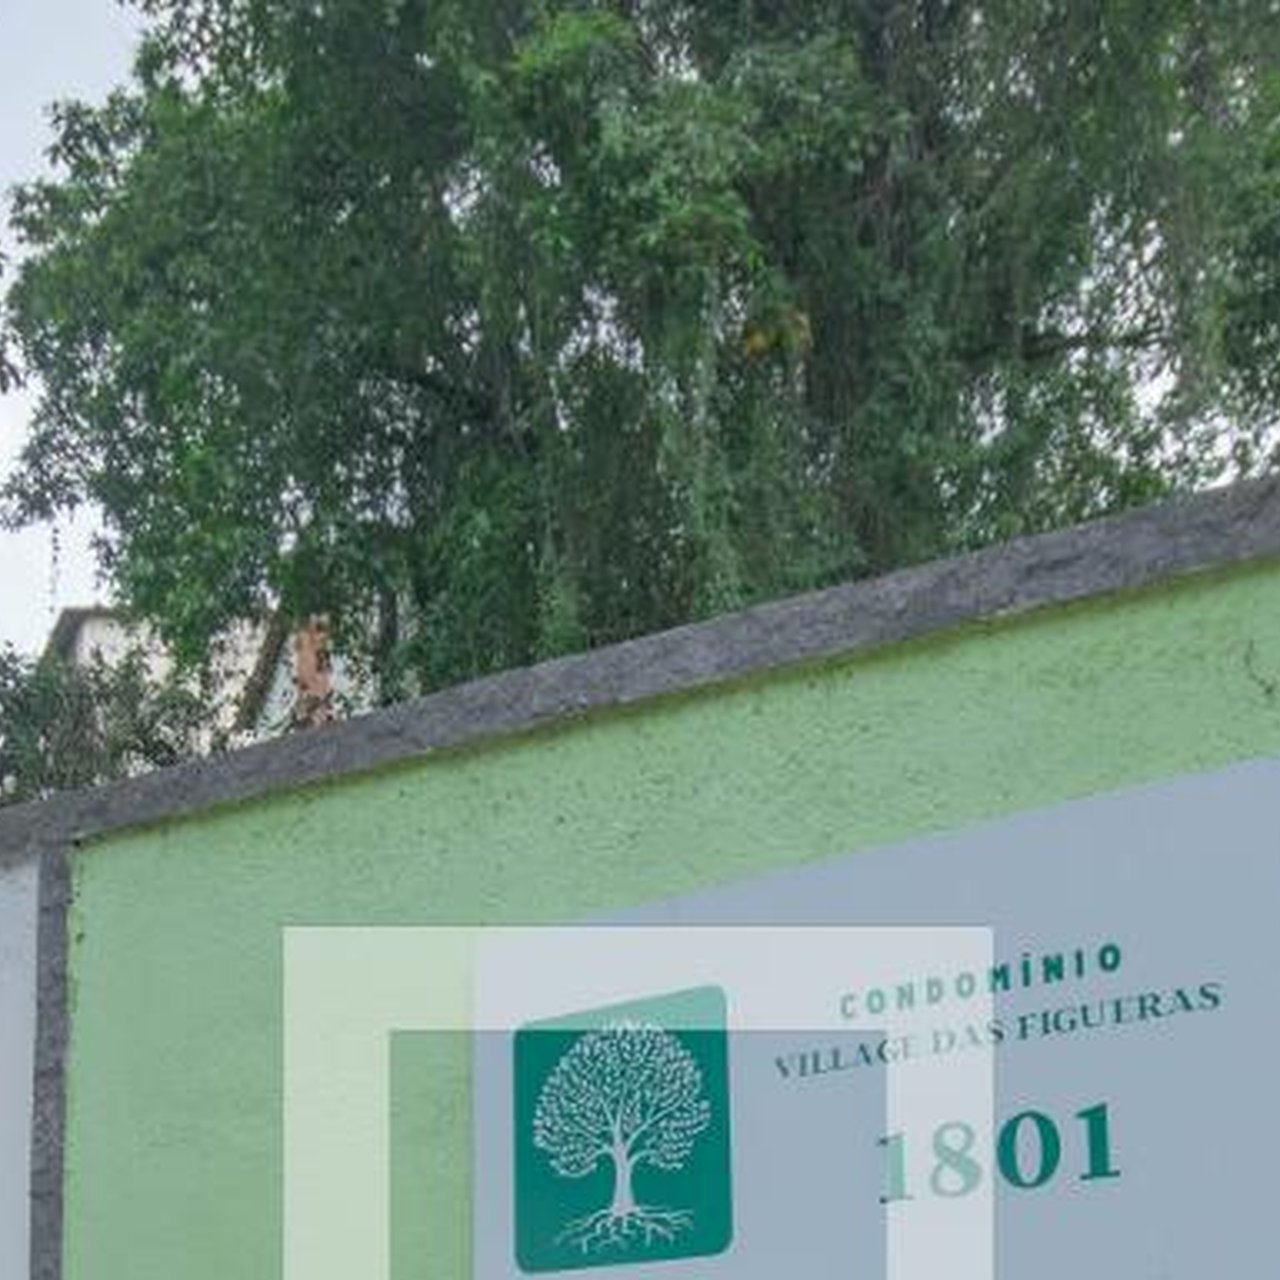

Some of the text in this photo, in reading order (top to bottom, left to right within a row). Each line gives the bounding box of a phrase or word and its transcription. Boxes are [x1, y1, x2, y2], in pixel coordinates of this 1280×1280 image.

[840, 943, 1122, 1020] CONDOMÍNIO
[774, 982, 1222, 1079] VILLAGE DAS FIGUERAS
[877, 1102, 1122, 1204] 1801
